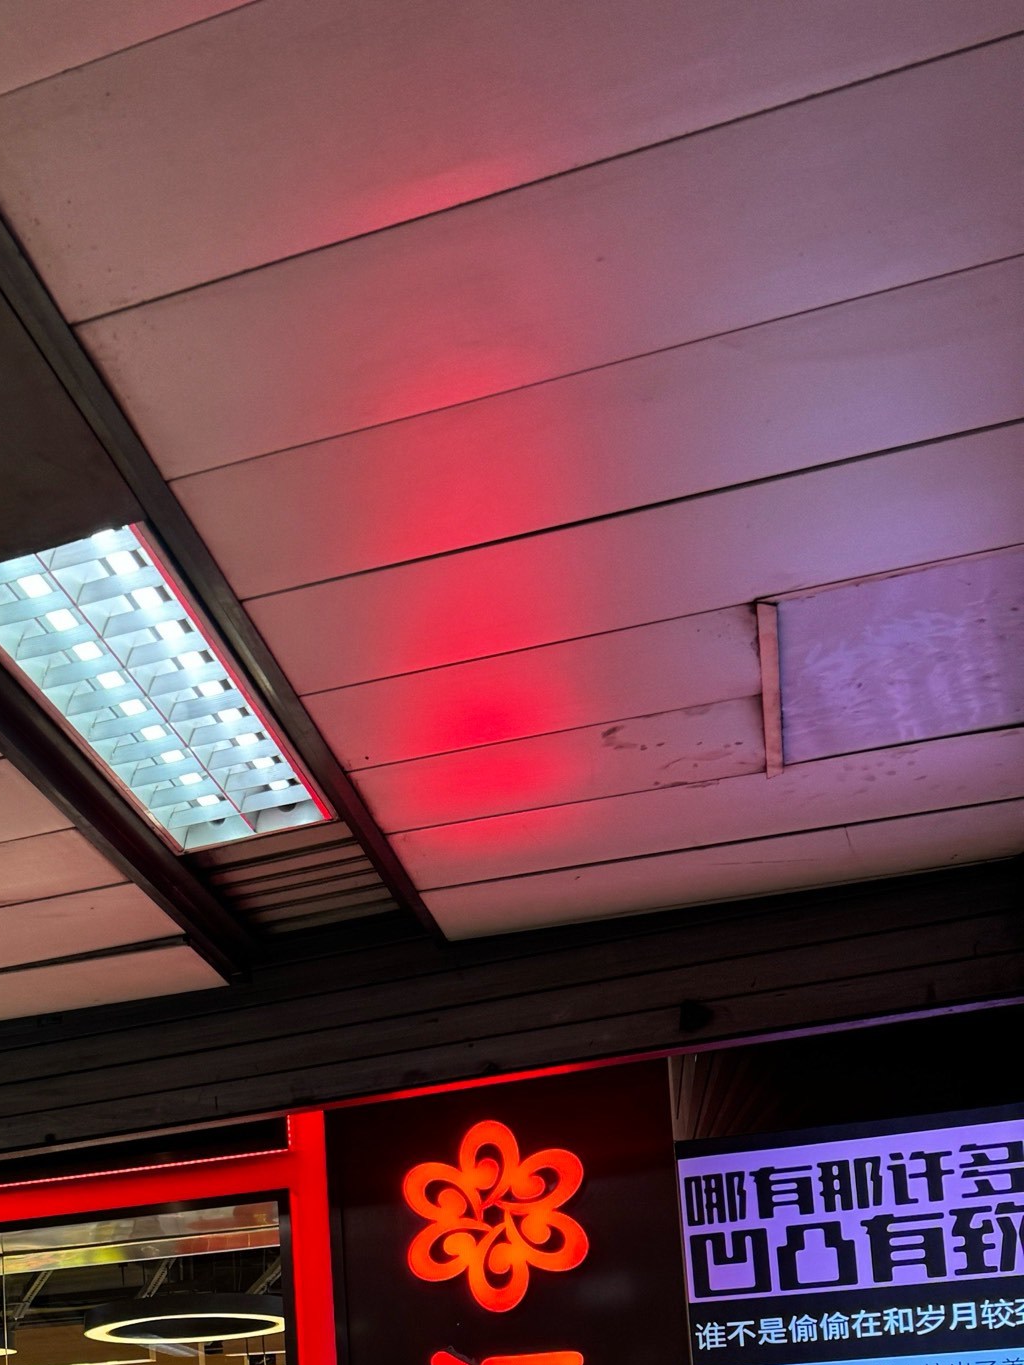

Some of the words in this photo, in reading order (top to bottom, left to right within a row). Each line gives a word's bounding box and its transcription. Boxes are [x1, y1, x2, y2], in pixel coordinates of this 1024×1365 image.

[684, 1141, 1023, 1227] 哪有那许多
